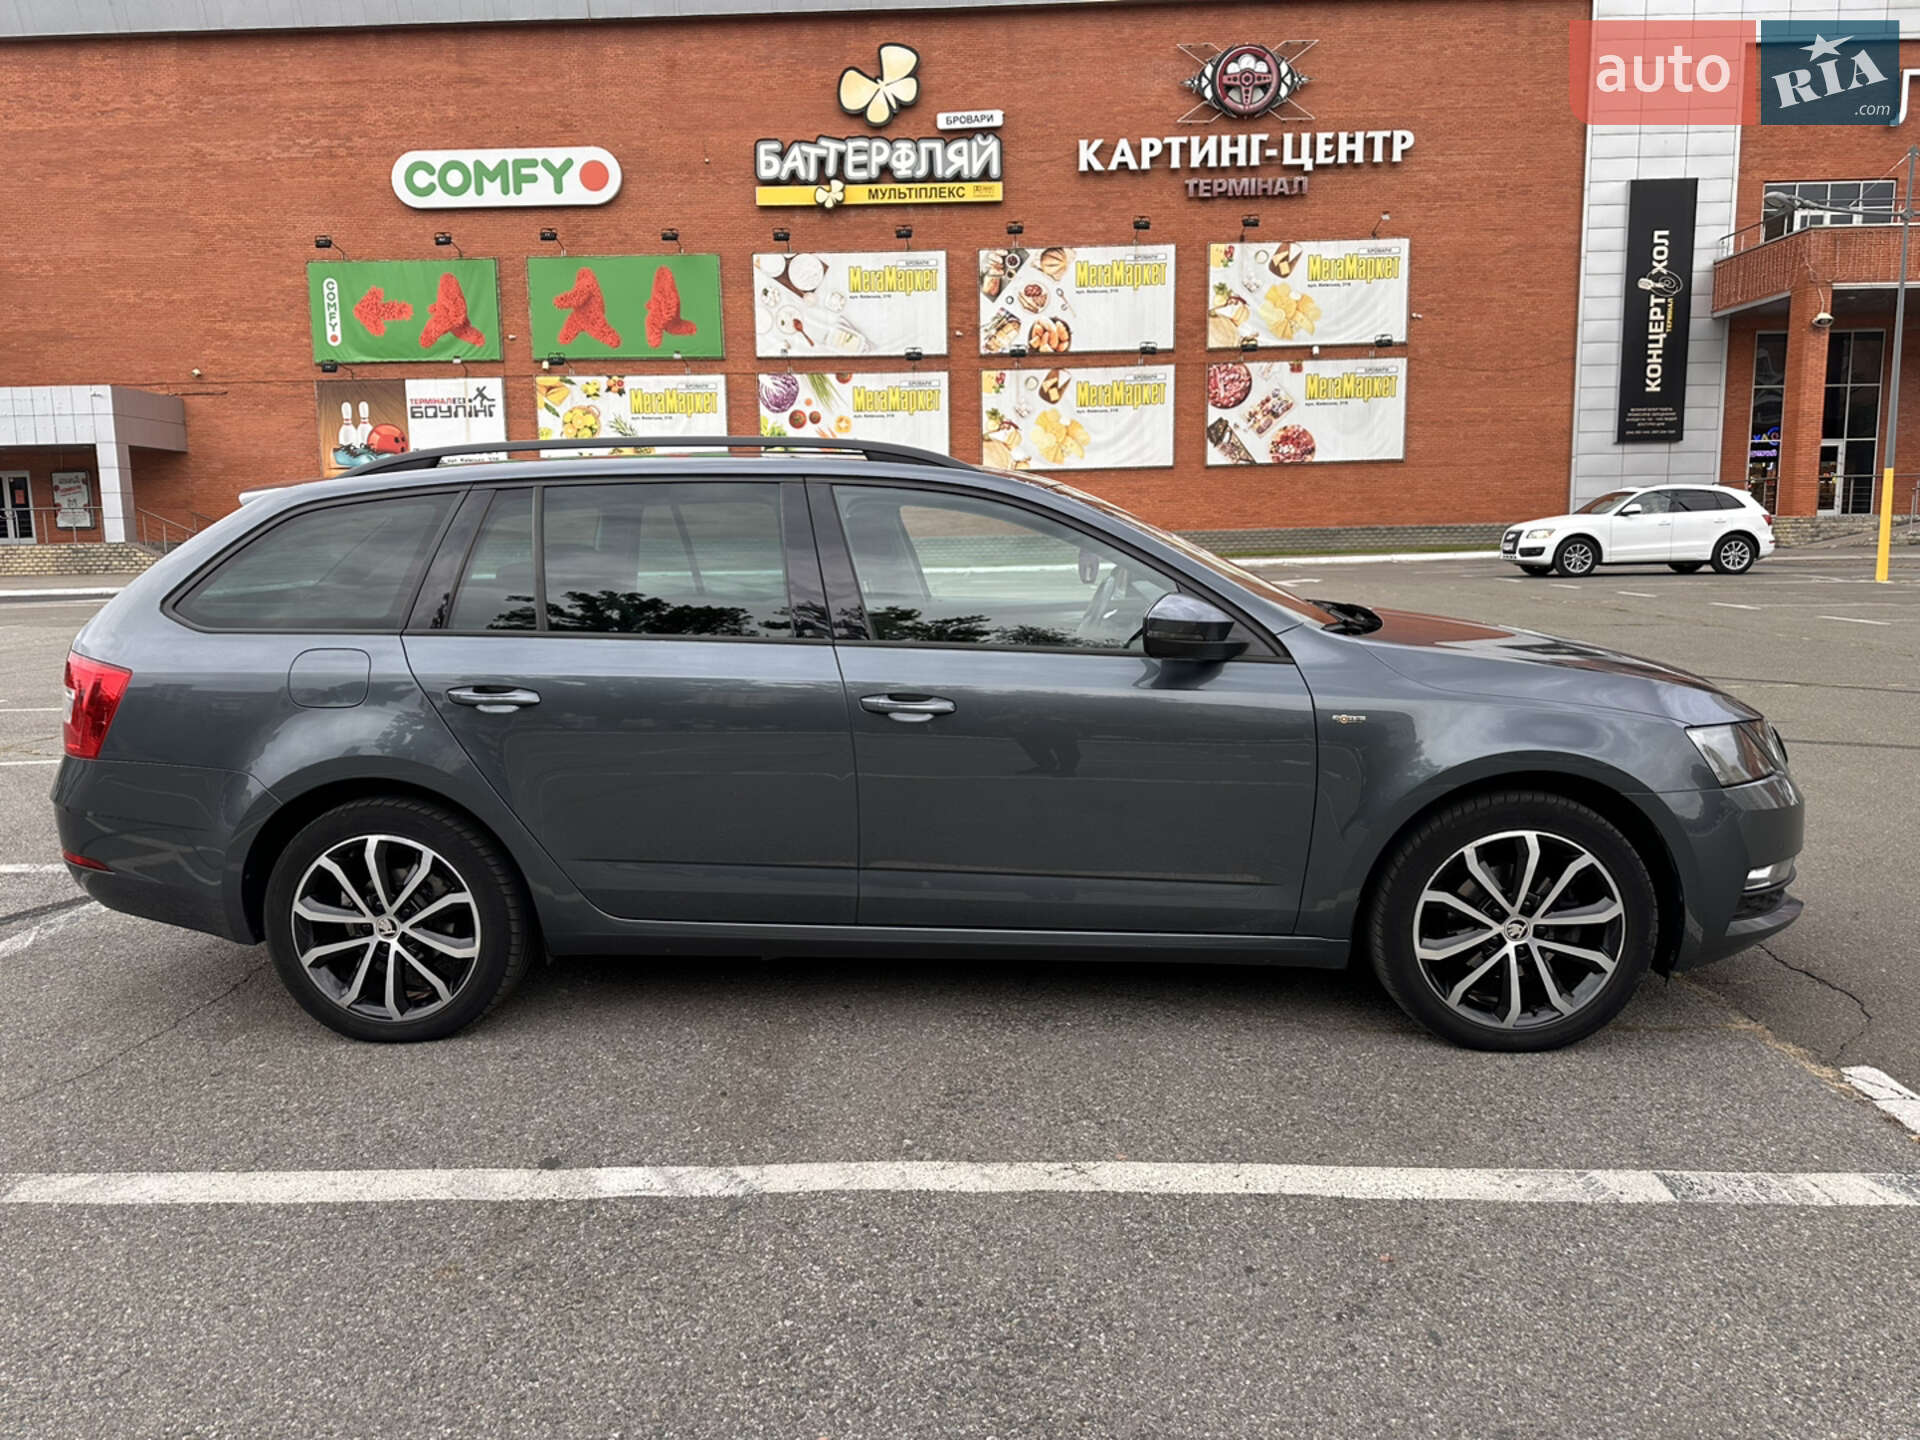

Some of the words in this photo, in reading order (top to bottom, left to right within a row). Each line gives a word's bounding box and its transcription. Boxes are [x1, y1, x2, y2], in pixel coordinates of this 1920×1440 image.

[945, 114, 994, 125] БРОВАРИ
[756, 134, 1002, 181] БАТТЕРФЛЯЙ
[1078, 130, 1415, 172] КАРТИНГ-ЦЕНТР
[404, 157, 575, 197] COMFY
[1184, 176, 1308, 199] ТЕРМІНАЛ
[867, 186, 966, 200] МУЛЬТІПЛЕКС
[1652, 229, 1670, 274] ХОЛ
[848, 265, 938, 296] МегаМаркет
[1075, 259, 1167, 290] МегаМаркет
[1308, 253, 1400, 284] МегаМаркет
[326, 281, 338, 332] COMFY
[1645, 294, 1667, 392] КОНЦЕРТ
[629, 388, 718, 418] МегаМаркет
[853, 386, 940, 416] МегаМаркет
[1076, 380, 1166, 410] МегаМаркет
[1306, 372, 1398, 403] МегаМаркет
[410, 404, 496, 419] БОУЛІНГ
